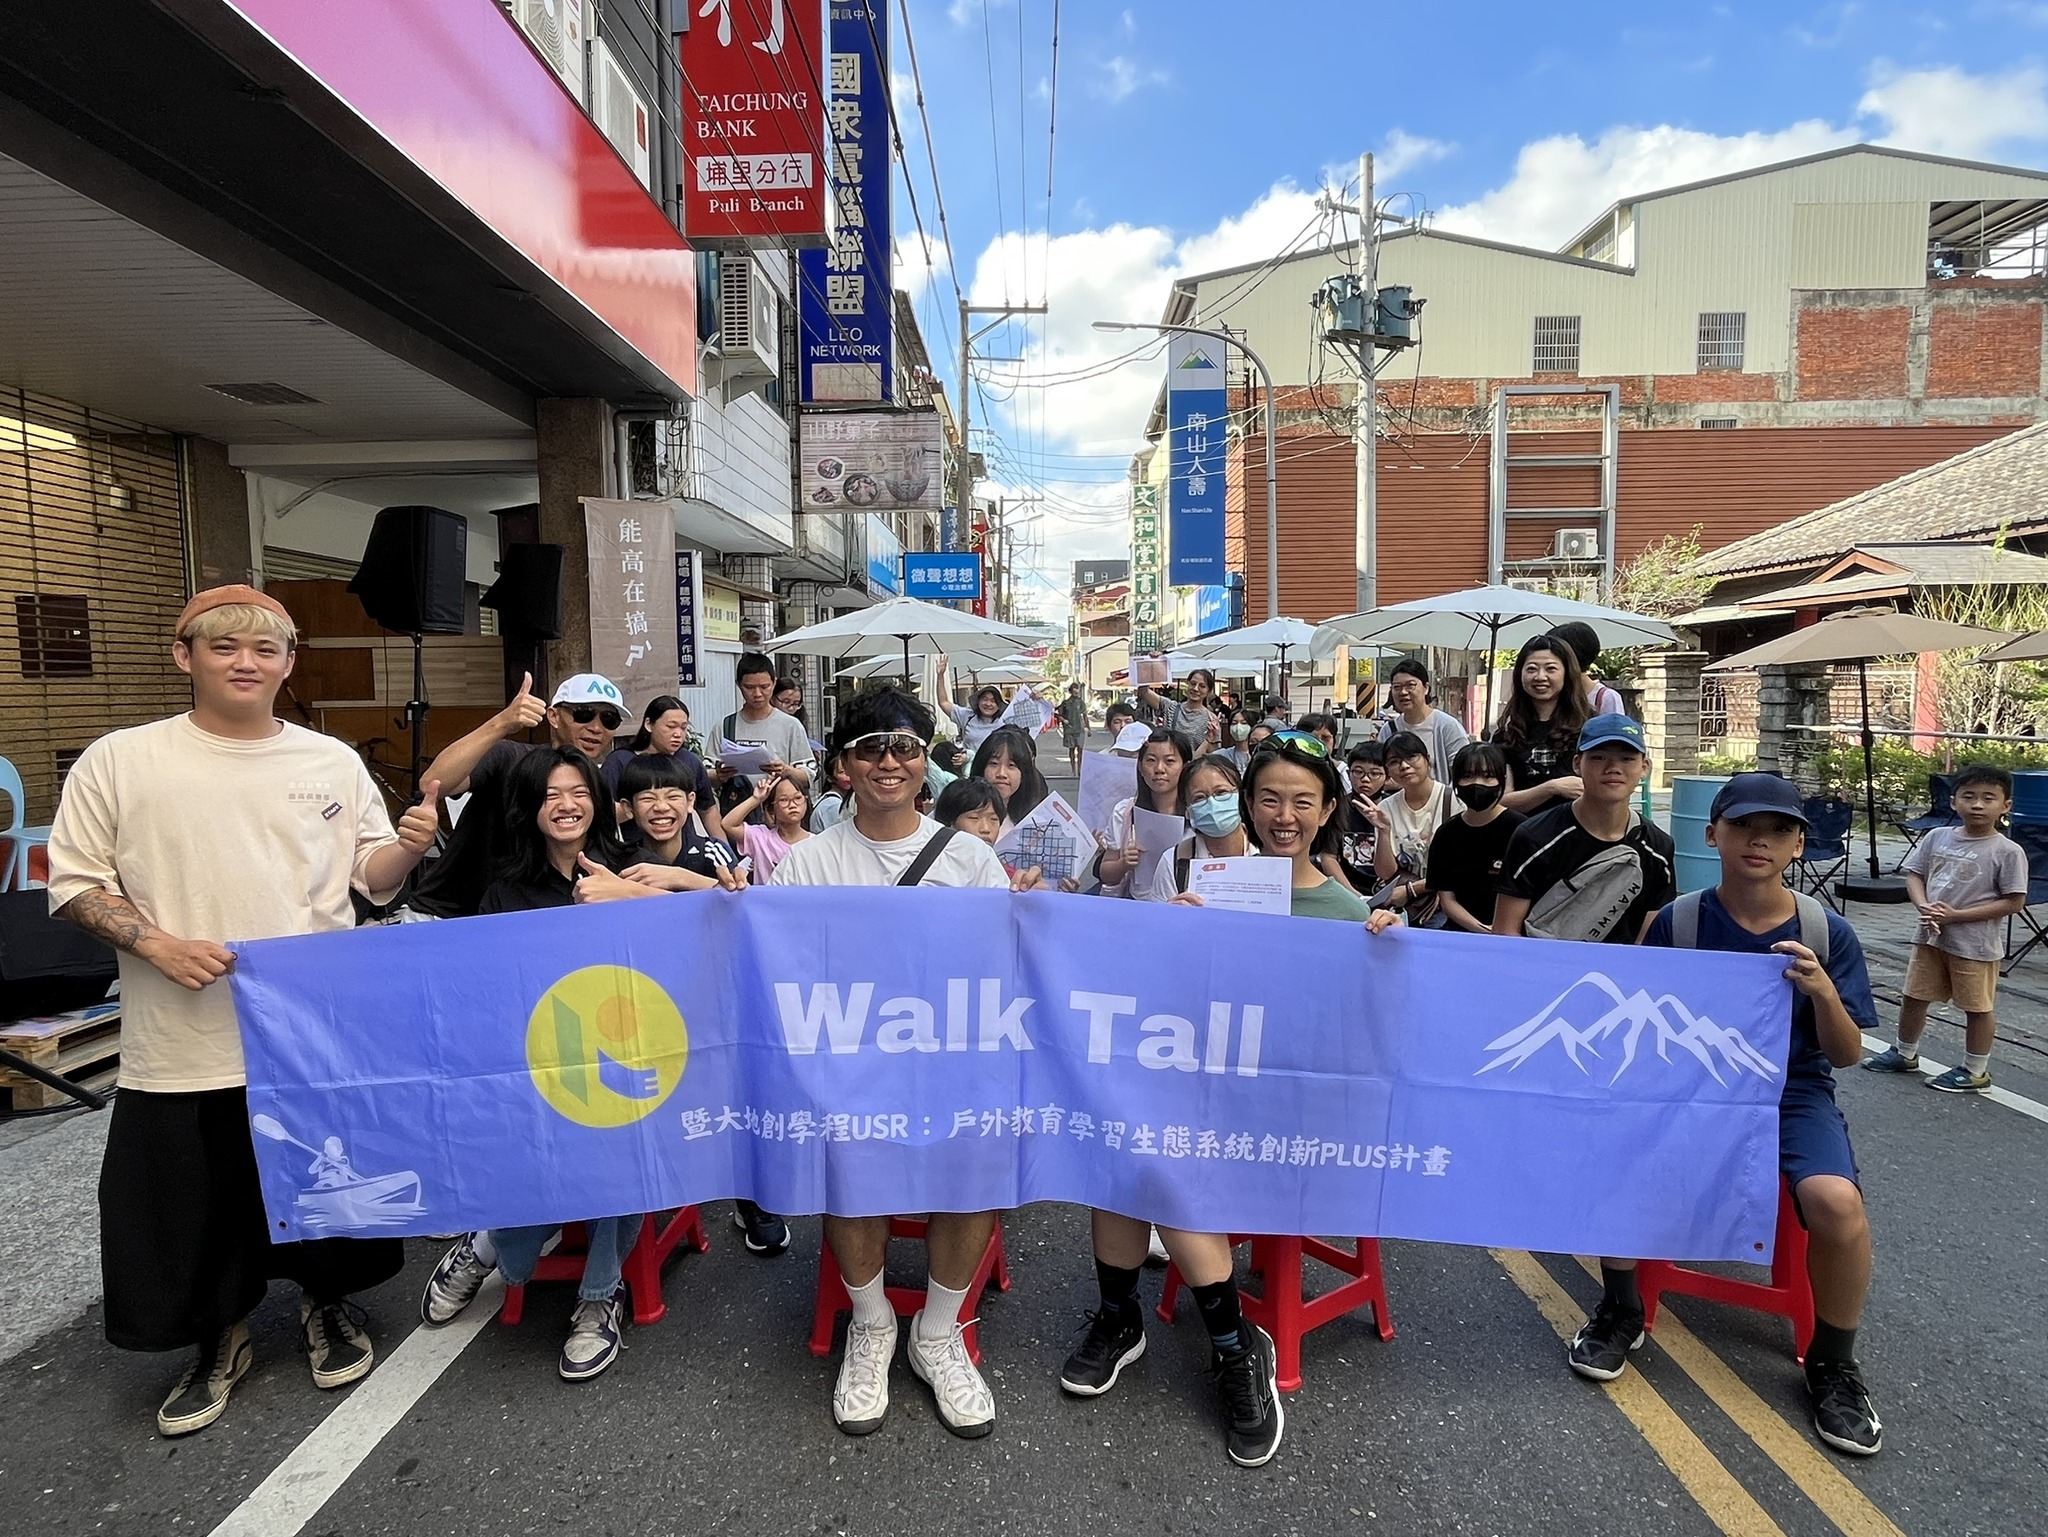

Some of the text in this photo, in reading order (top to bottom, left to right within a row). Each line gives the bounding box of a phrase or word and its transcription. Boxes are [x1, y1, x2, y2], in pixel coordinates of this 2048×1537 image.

[698, 91, 808, 113] TAICHUNG
[697, 119, 757, 138] BANK
[706, 158, 803, 186] 埔里分行
[709, 196, 805, 214] Puli Branch
[829, 328, 863, 342] LEO
[811, 345, 881, 357] NETWORK
[1188, 412, 1207, 496] 南山人壽
[1134, 487, 1156, 623] 文和堂書局
[774, 978, 1264, 1077] Walk Tall
